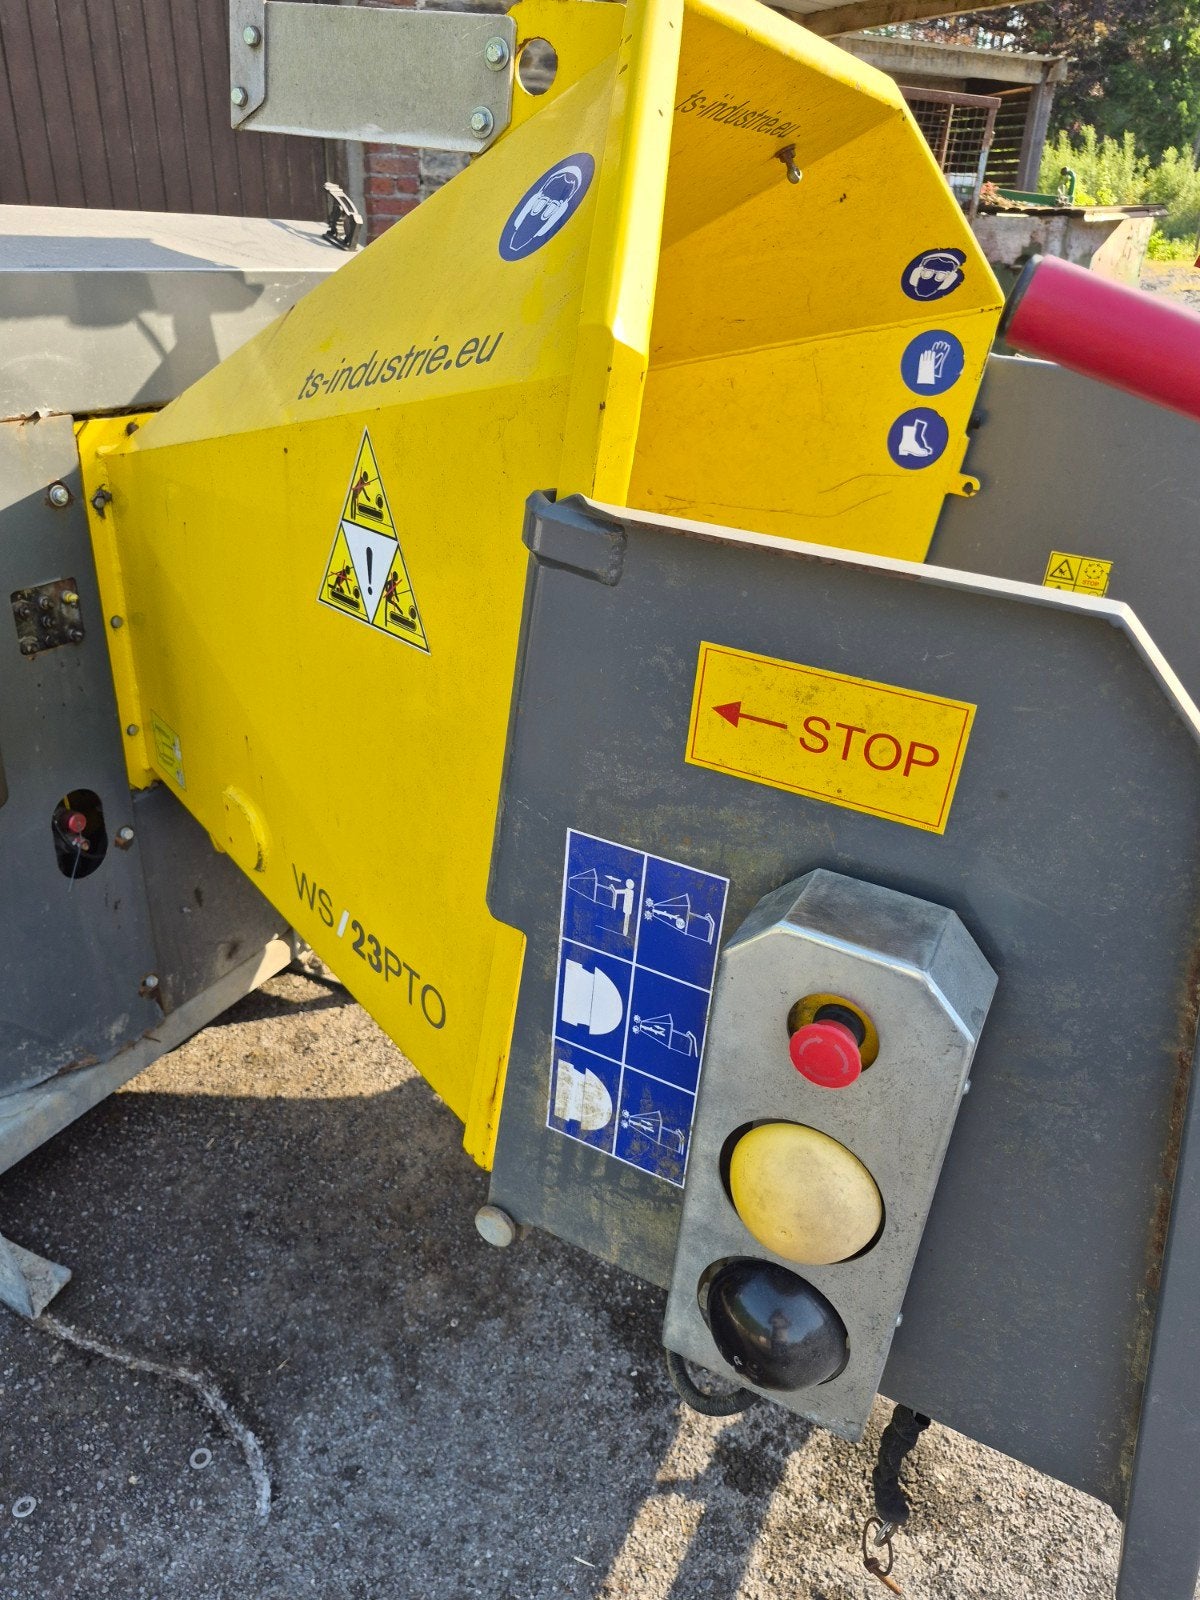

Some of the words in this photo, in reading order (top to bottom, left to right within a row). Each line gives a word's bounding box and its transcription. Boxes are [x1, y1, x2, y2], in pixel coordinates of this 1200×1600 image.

[674, 90, 801, 138] ts-industrie.eu
[297, 332, 504, 400] ts-industrie.eu
[799, 716, 940, 777] STOP
